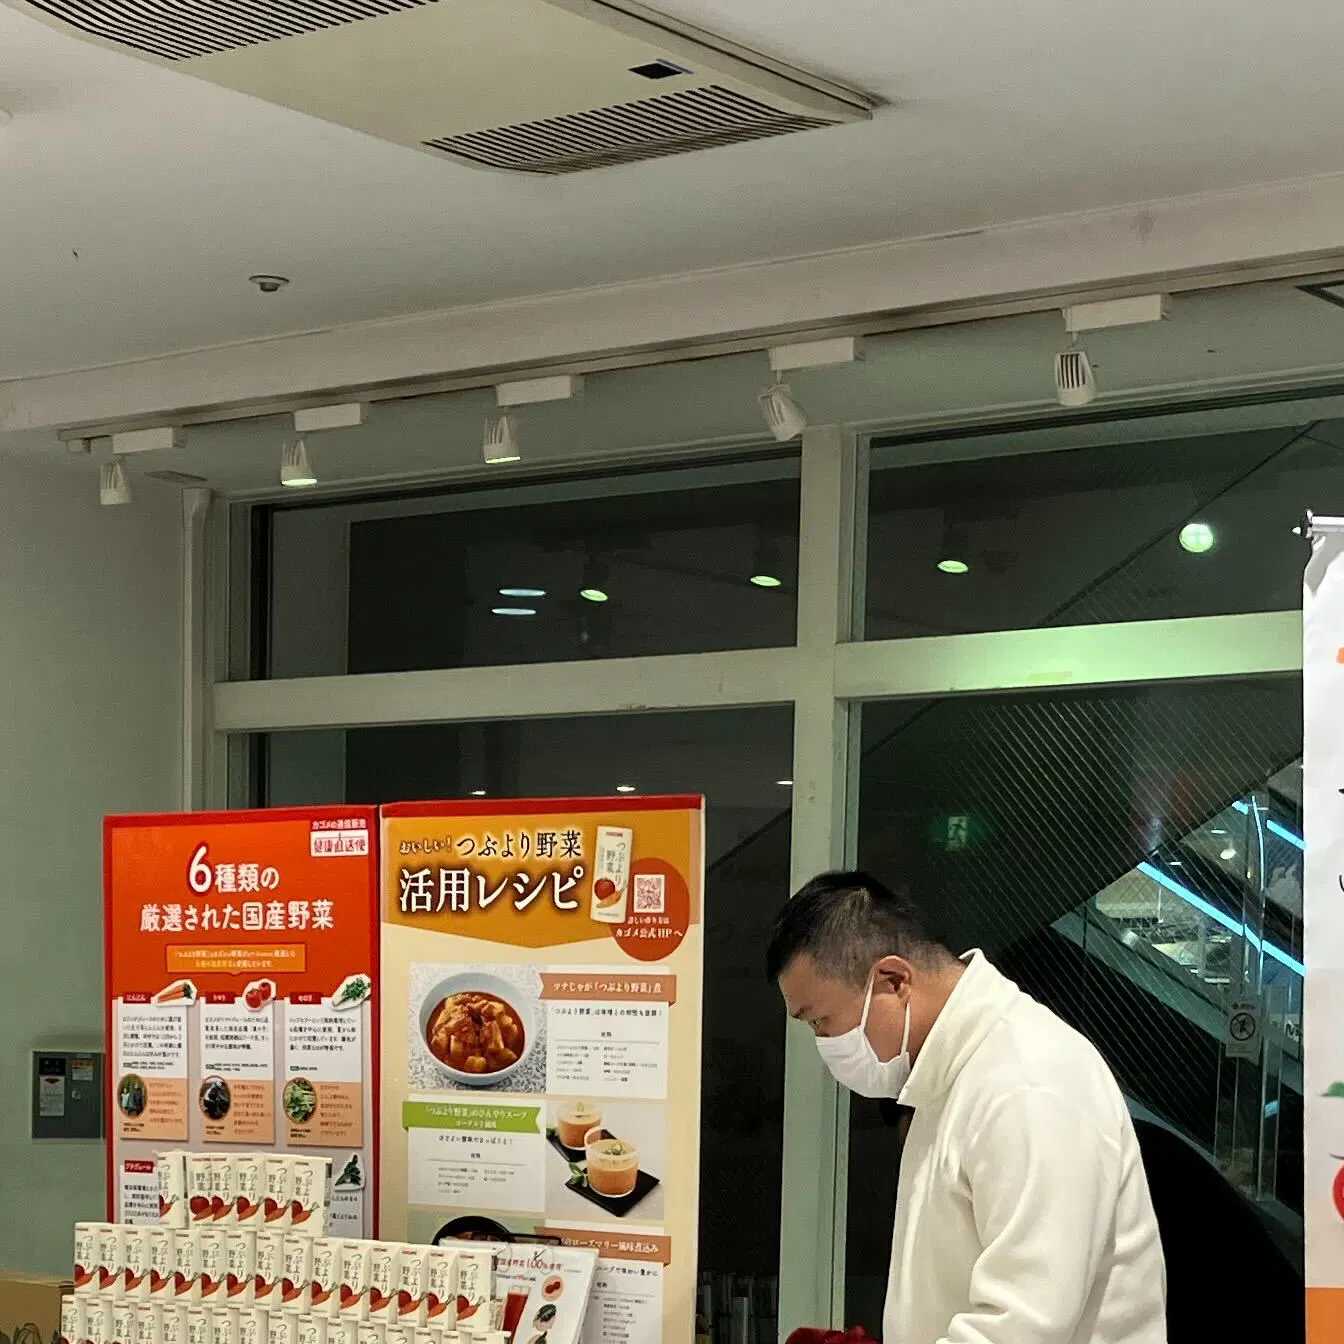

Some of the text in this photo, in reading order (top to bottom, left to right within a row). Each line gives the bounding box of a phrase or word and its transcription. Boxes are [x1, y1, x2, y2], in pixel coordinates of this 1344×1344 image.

[456, 830, 582, 859] つぶより野菜
[189, 845, 280, 893] 6種類の
[399, 866, 585, 913] 活用レシピ
[140, 899, 334, 932] 厳選された国産野菜
